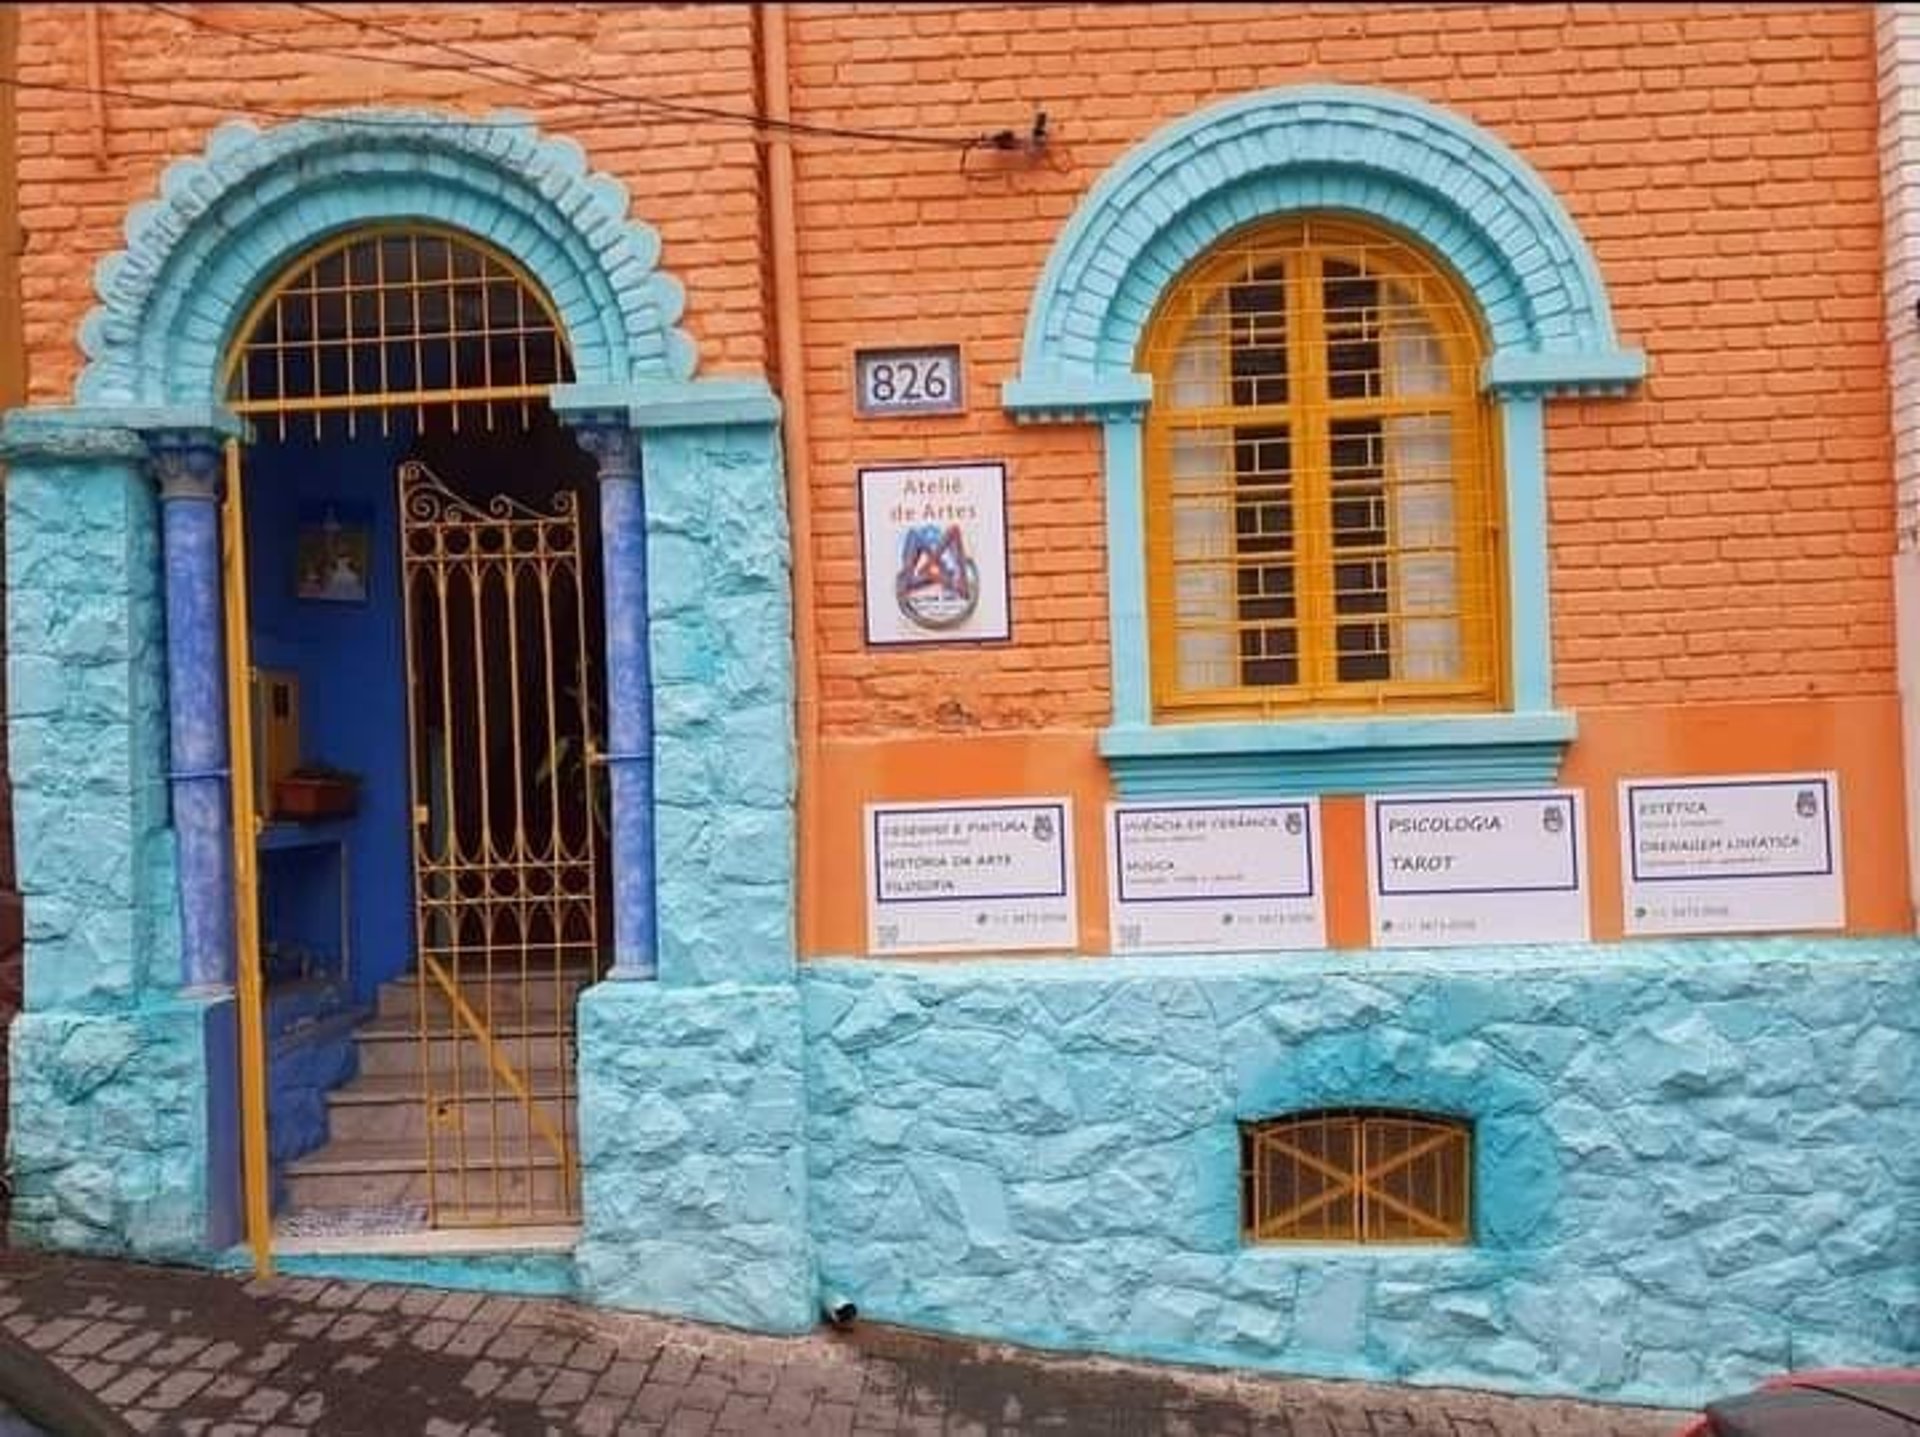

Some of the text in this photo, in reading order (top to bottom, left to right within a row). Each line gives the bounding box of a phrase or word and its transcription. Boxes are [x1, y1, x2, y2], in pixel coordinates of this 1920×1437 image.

[872, 362, 947, 401] 826
[891, 503, 977, 521] de Artes
[953, 822, 961, 835] E
[967, 820, 1027, 834] PINTURA
[1187, 818, 1206, 831] EM
[1388, 815, 1502, 833] PSICOLOGIA
[1640, 837, 1722, 852] DRENAGEM
[951, 855, 972, 868] DA
[976, 854, 1012, 867] ARTE
[1390, 855, 1455, 872] TAROT
[885, 879, 954, 893] FILOSOFIA
